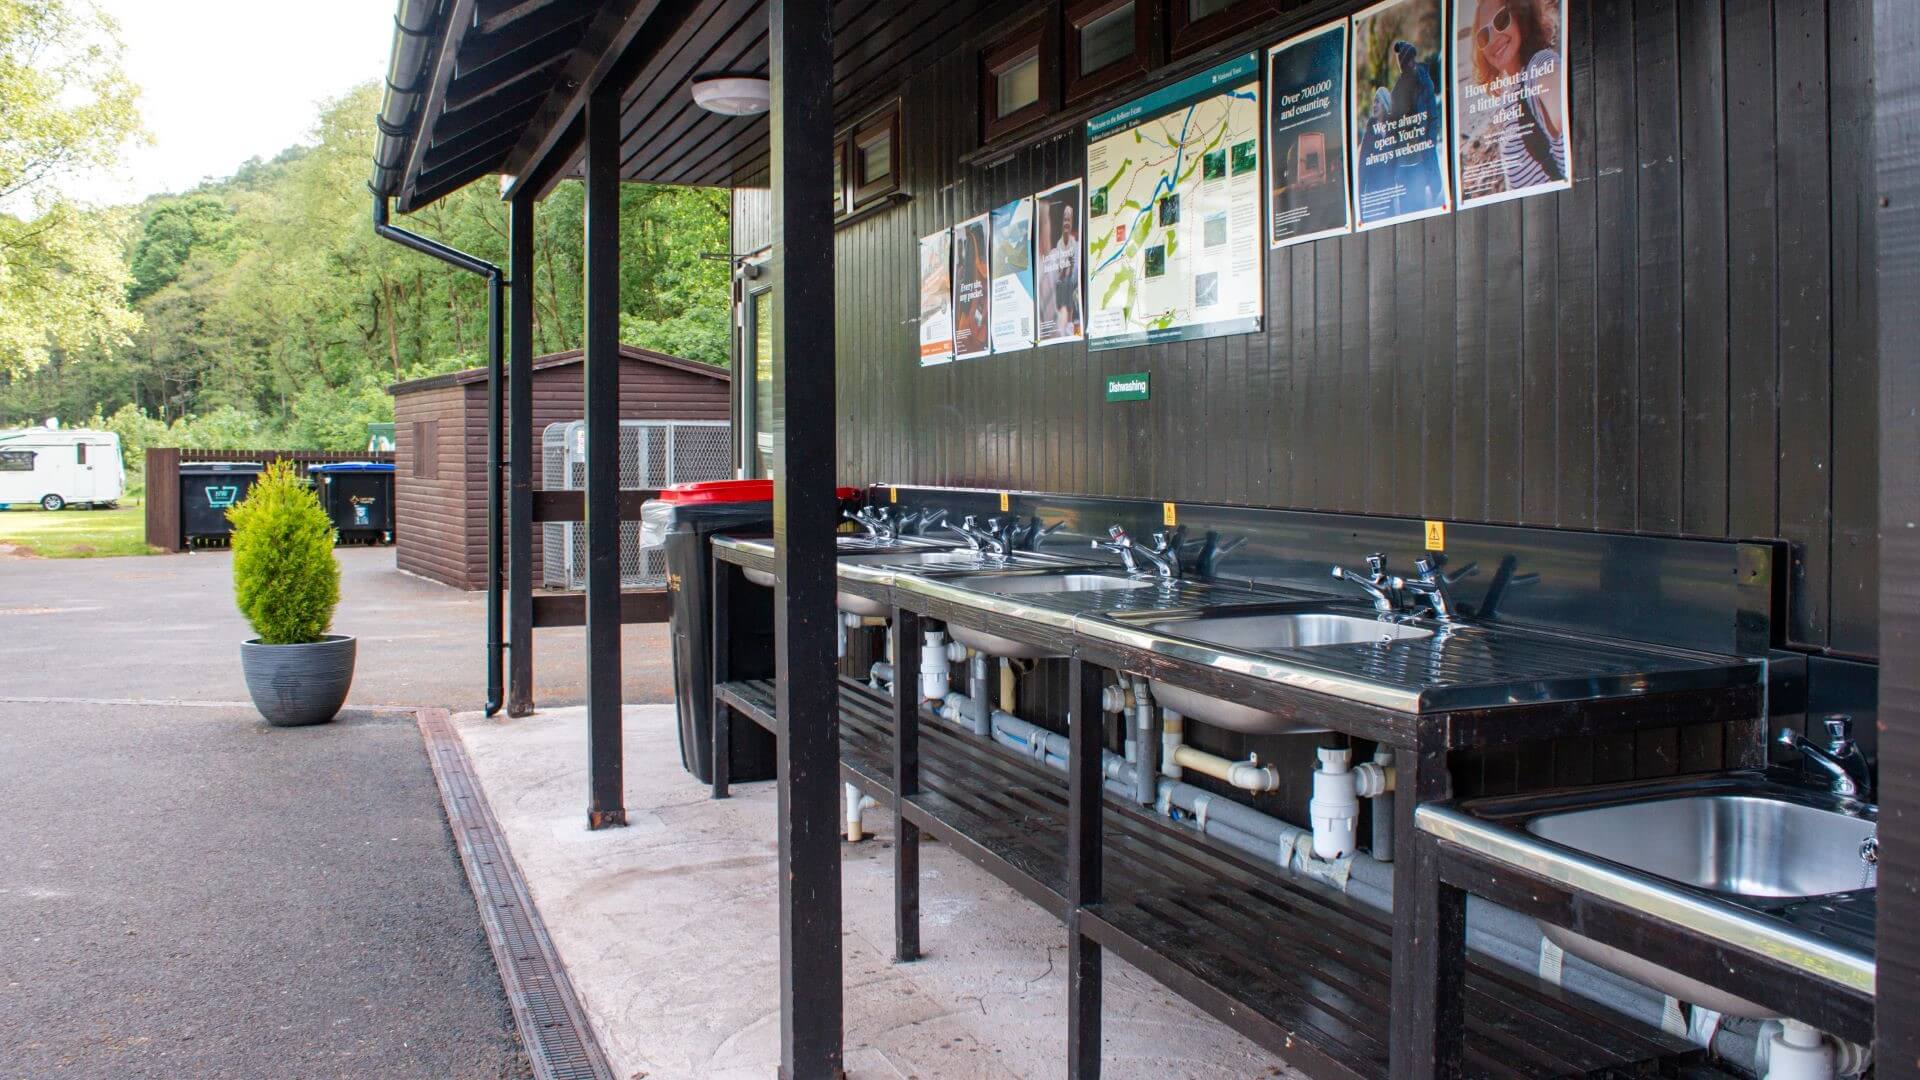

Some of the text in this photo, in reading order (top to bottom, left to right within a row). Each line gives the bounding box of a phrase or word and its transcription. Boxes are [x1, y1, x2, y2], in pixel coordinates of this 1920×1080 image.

[1464, 60, 1554, 98] How about a field
[1281, 93, 1300, 107] Over
[1281, 106, 1295, 120] and
[1295, 96, 1330, 115] counting.
[1469, 103, 1476, 114] a
[1477, 94, 1500, 112] little
[1372, 111, 1428, 135] We're always
[1492, 104, 1525, 125] afield.
[1374, 126, 1426, 151] open. You're
[1365, 139, 1435, 166] always welcome.
[1109, 379, 1146, 393] Dishwashing
